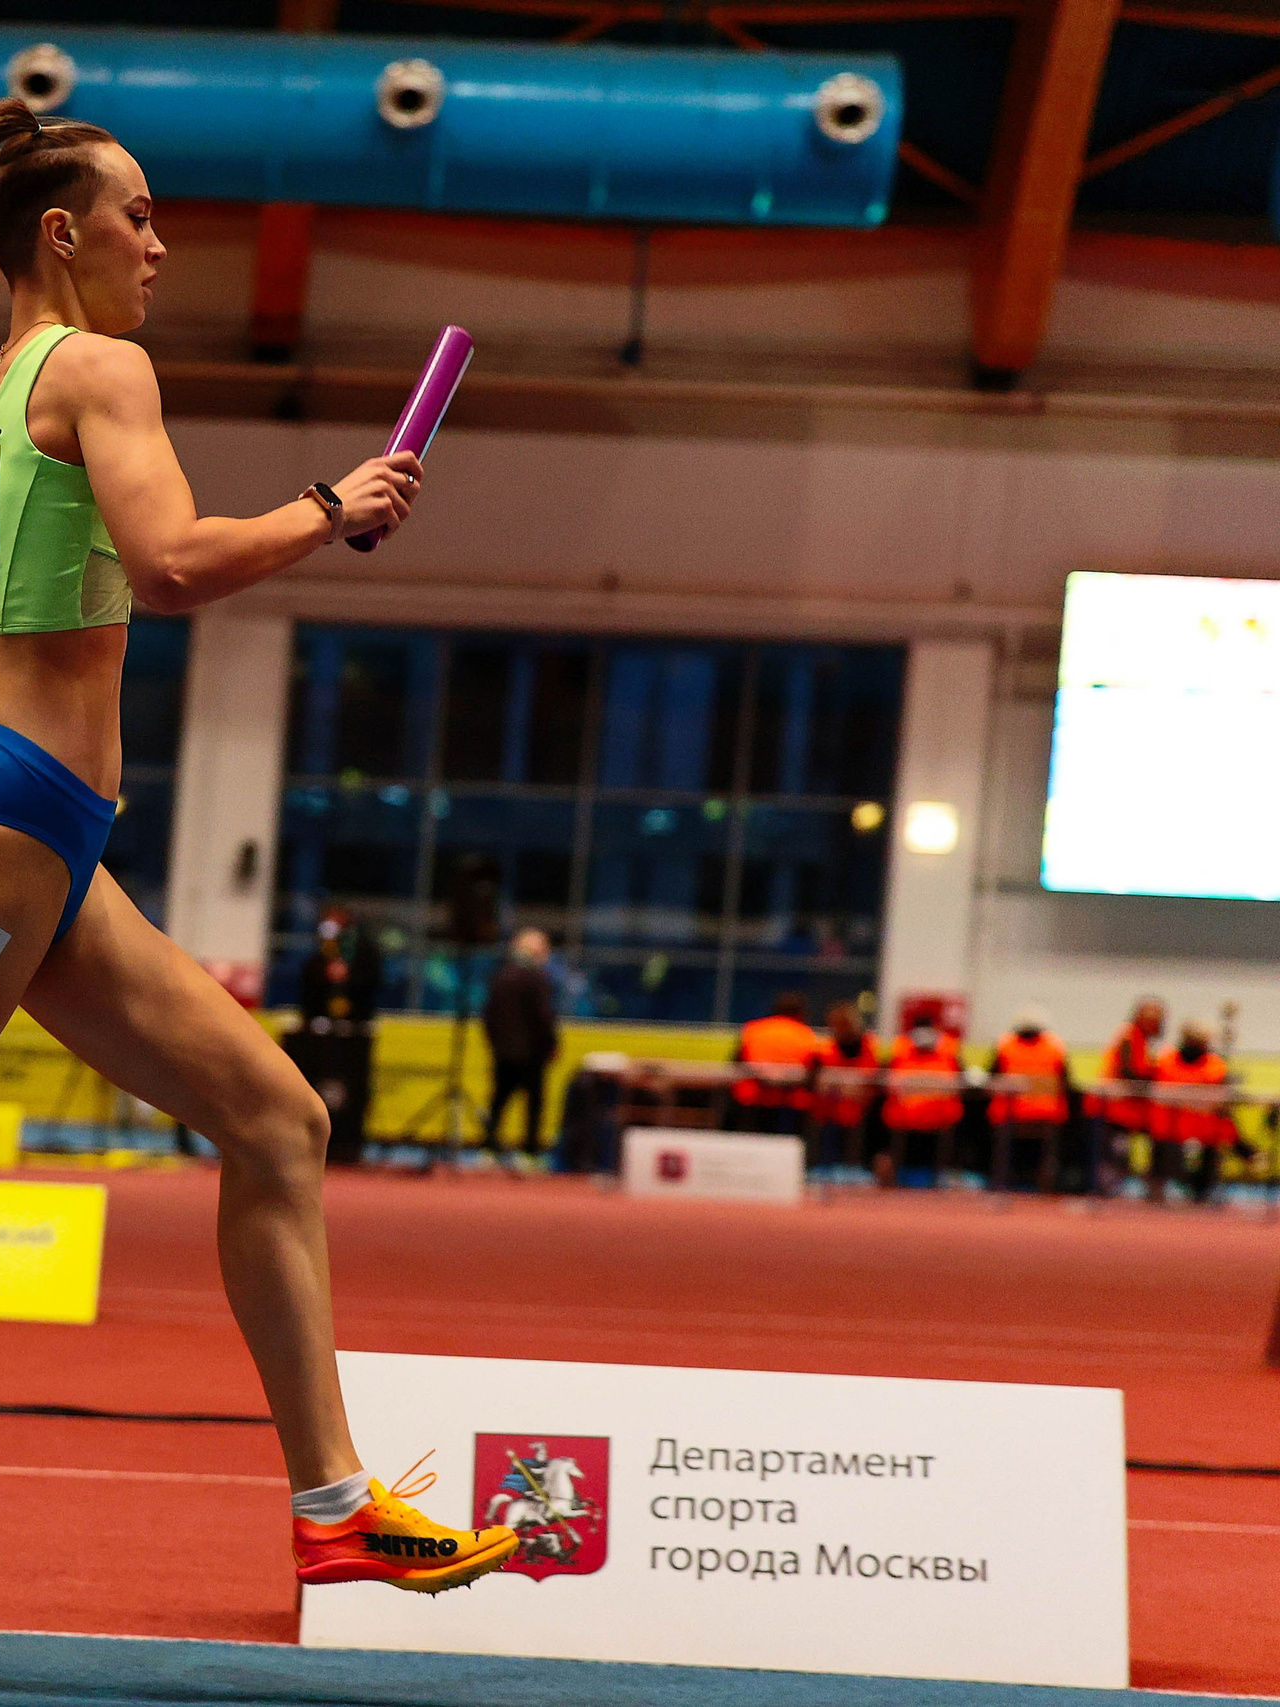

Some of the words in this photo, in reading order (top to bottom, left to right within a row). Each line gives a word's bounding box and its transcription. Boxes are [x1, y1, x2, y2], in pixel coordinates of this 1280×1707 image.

[649, 1437, 937, 1481] Департамент
[650, 1492, 799, 1530] спорта
[363, 1533, 458, 1558] NITRO
[649, 1542, 801, 1581] города
[815, 1543, 989, 1583] Москвы
